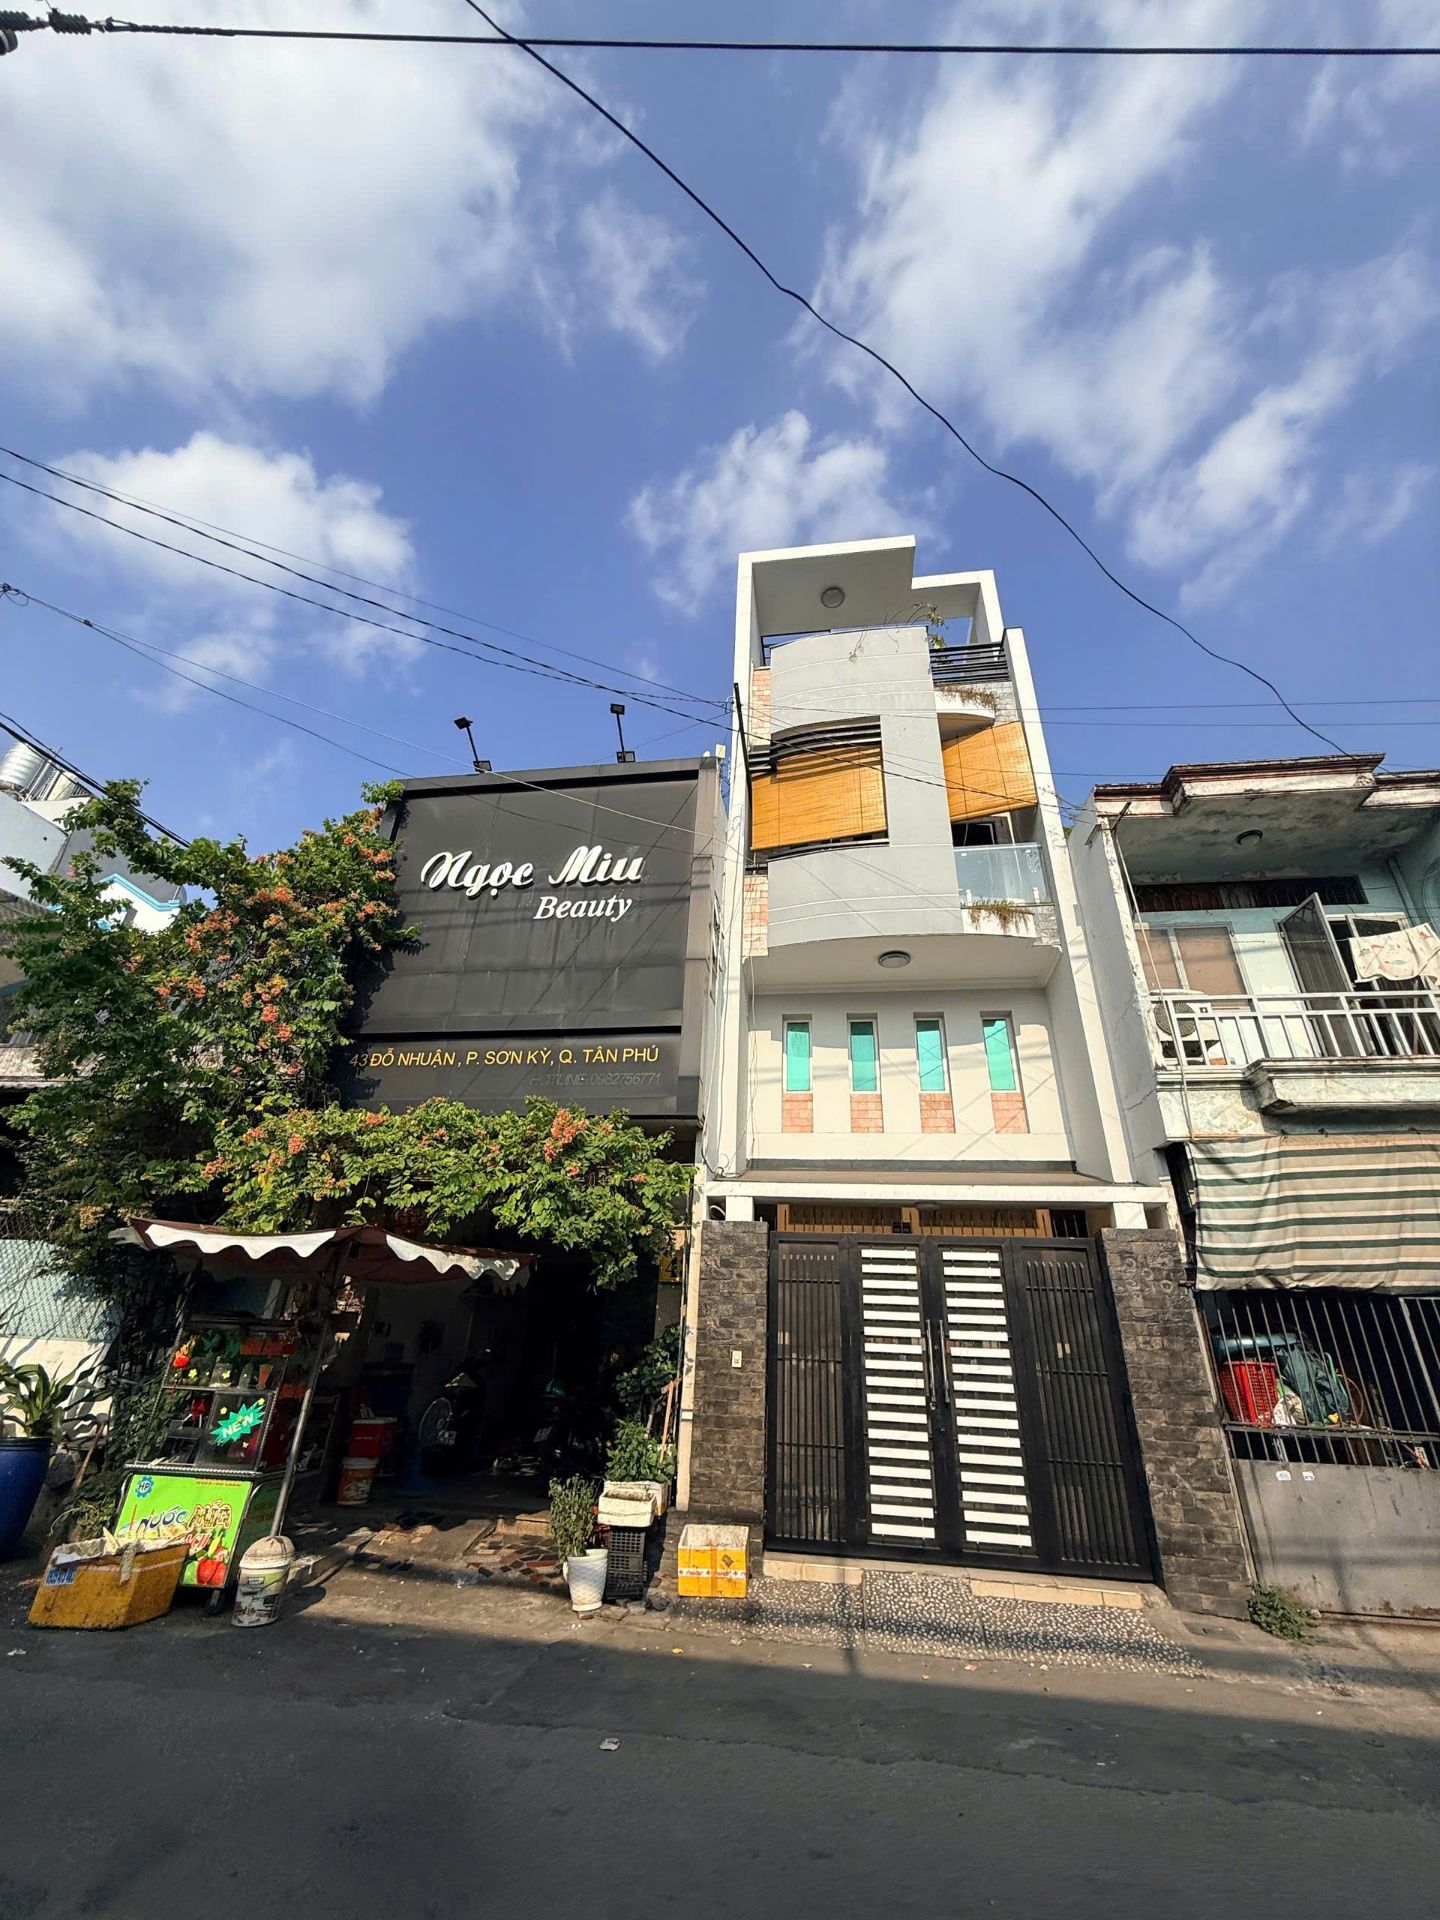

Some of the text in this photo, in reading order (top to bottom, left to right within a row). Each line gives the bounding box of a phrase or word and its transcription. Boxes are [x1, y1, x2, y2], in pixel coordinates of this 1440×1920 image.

[420, 845, 644, 898] Ngọc Miu
[533, 894, 633, 923] Beauty
[369, 1047, 395, 1067] ĐỖ
[466, 1051, 480, 1066] P.
[484, 1050, 523, 1065] SƠN
[558, 1049, 577, 1064] Q.
[582, 1045, 618, 1063] TÂN
[622, 1044, 659, 1062] PHÚ
